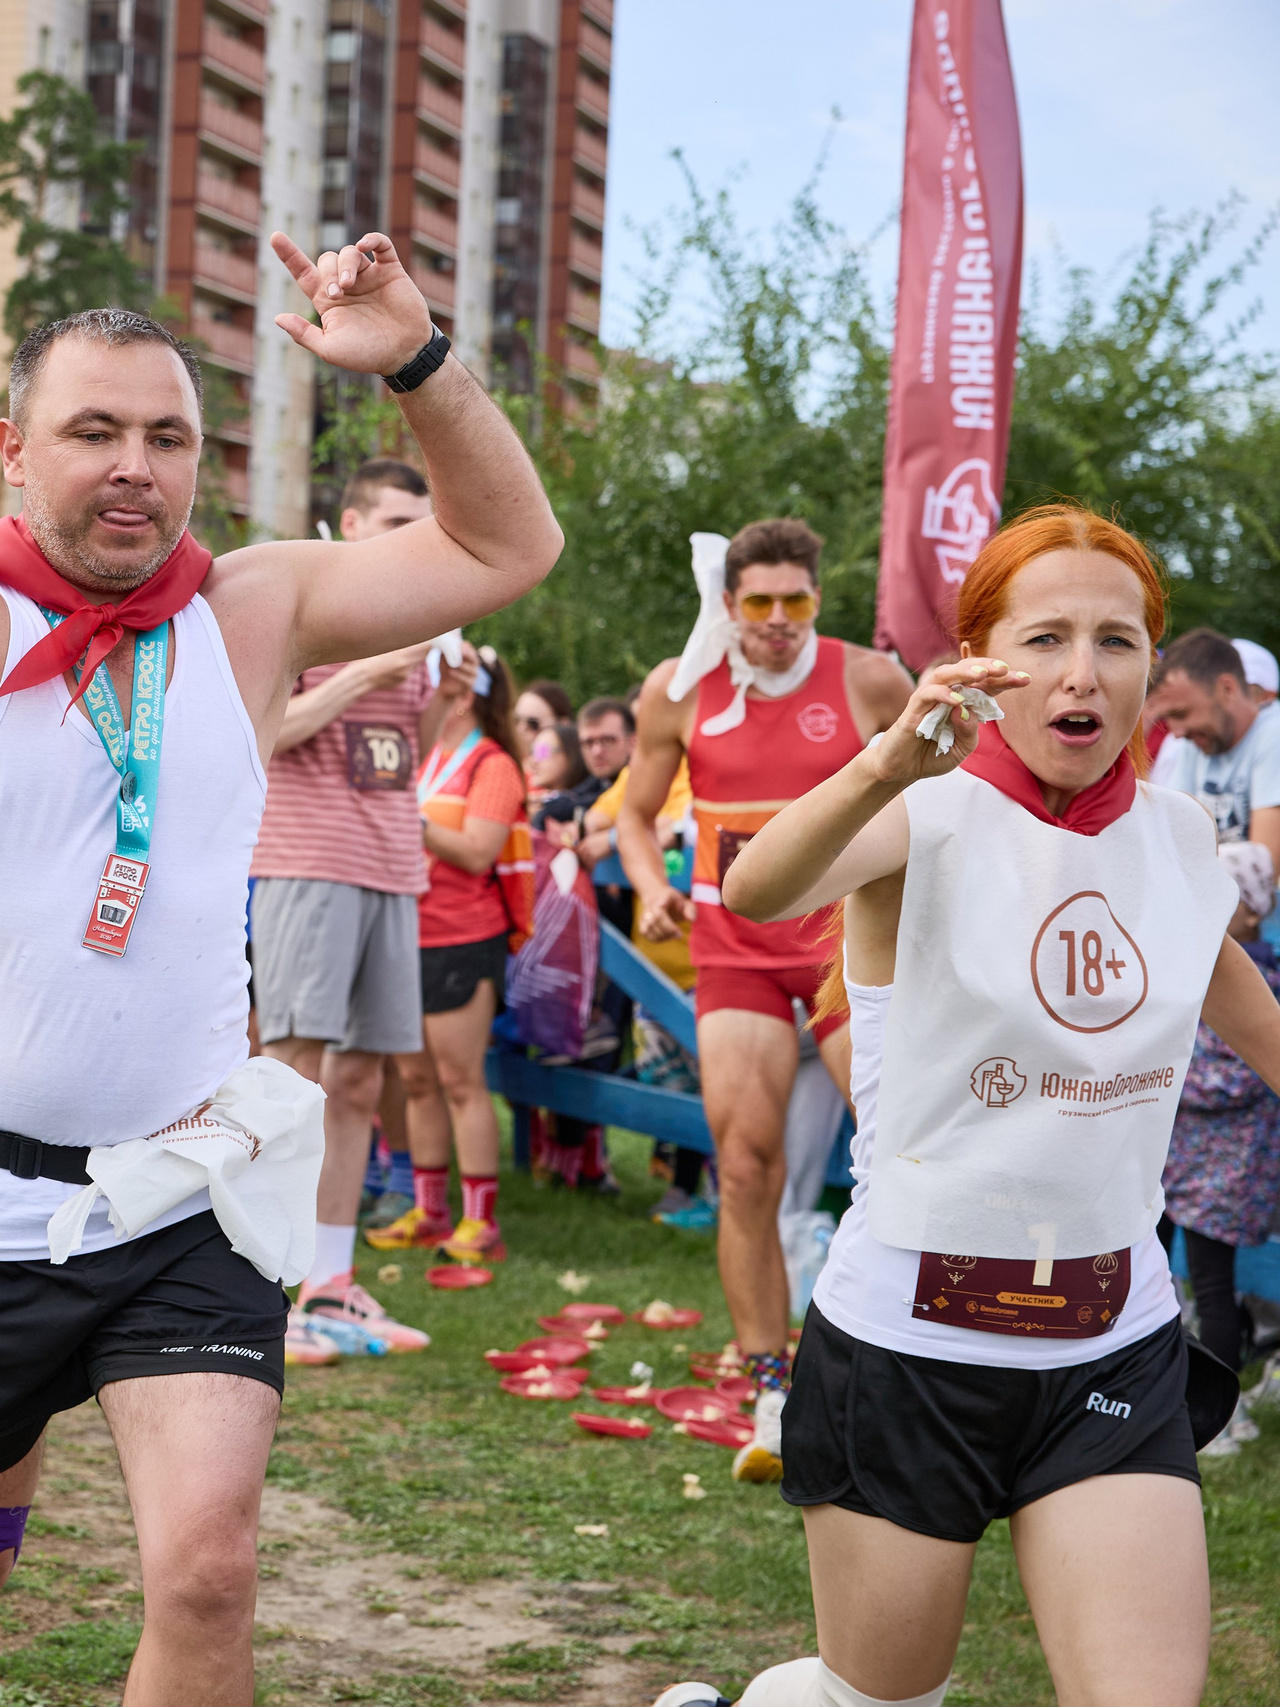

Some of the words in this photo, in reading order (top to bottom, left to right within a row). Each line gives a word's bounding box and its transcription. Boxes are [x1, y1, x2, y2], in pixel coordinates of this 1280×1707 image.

[137, 640, 156, 699] КРОСС
[152, 641, 165, 720] физкультурника
[133, 702, 153, 761] РЕТРО
[152, 723, 160, 745] дню
[150, 746, 157, 761] ко
[368, 738, 400, 771] 10
[113, 869, 138, 882] КРОСС
[115, 863, 138, 875] РЕТРО
[1059, 930, 1127, 997] 18+
[1058, 1109, 1102, 1118] грузинский
[162, 1134, 209, 1144] грузинский
[1009, 1295, 1055, 1306] УЧАСТНИК
[1086, 1391, 1132, 1419] Run
